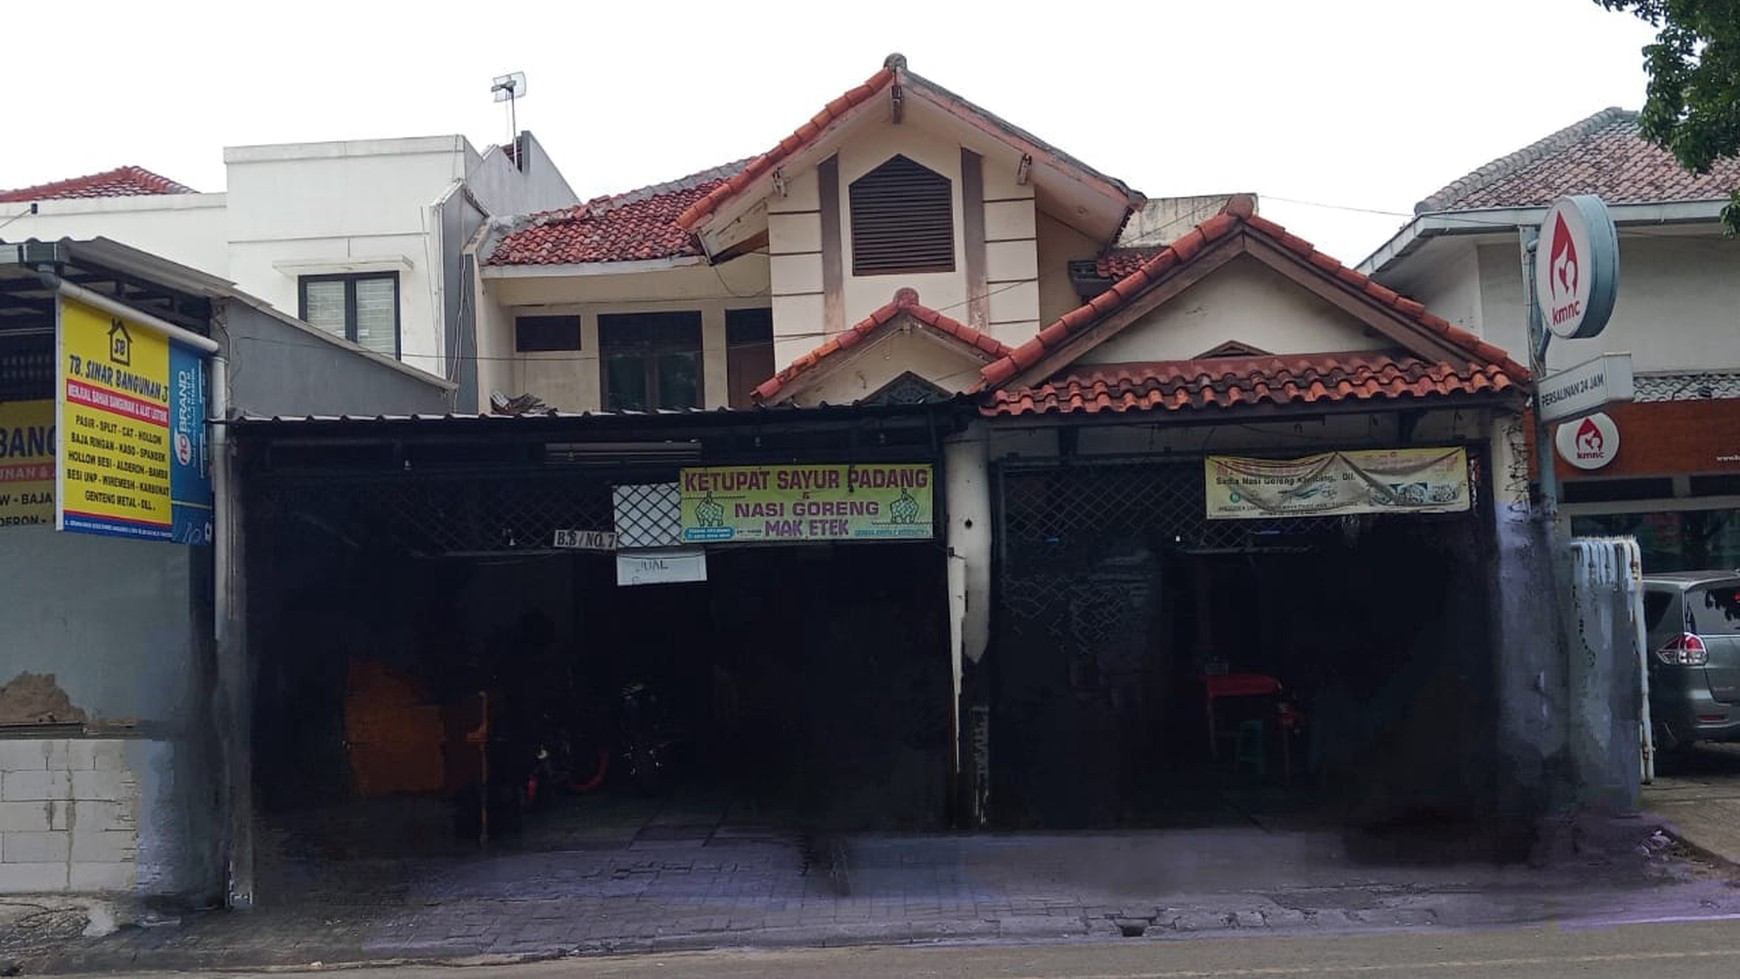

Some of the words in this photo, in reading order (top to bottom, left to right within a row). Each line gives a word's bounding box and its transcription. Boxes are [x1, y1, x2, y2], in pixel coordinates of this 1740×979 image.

[1552, 301, 1580, 326] kmnc
[86, 360, 113, 387] SINAR
[115, 369, 161, 400] BANGUNAN
[161, 385, 168, 403] 3
[1541, 382, 1580, 408] PERSALINAN
[1580, 378, 1588, 394] 24
[1589, 373, 1604, 390] JAM
[178, 370, 188, 432] BRAND
[75, 415, 95, 429] PASIR
[100, 420, 117, 433] SPLIT
[122, 426, 134, 437] CAT
[71, 432, 88, 445] BAJA
[97, 456, 112, 469] BESI
[1576, 451, 1605, 459] kmnc
[67, 468, 83, 481] BESI
[685, 471, 770, 491] KETUPAT
[776, 470, 840, 490] SAYUR
[848, 468, 928, 489] PADANG
[21, 492, 53, 505] BAJA
[735, 502, 785, 518] NASI
[792, 500, 879, 517] GORENG
[765, 519, 801, 537] MAK
[809, 518, 849, 536] ETEK
